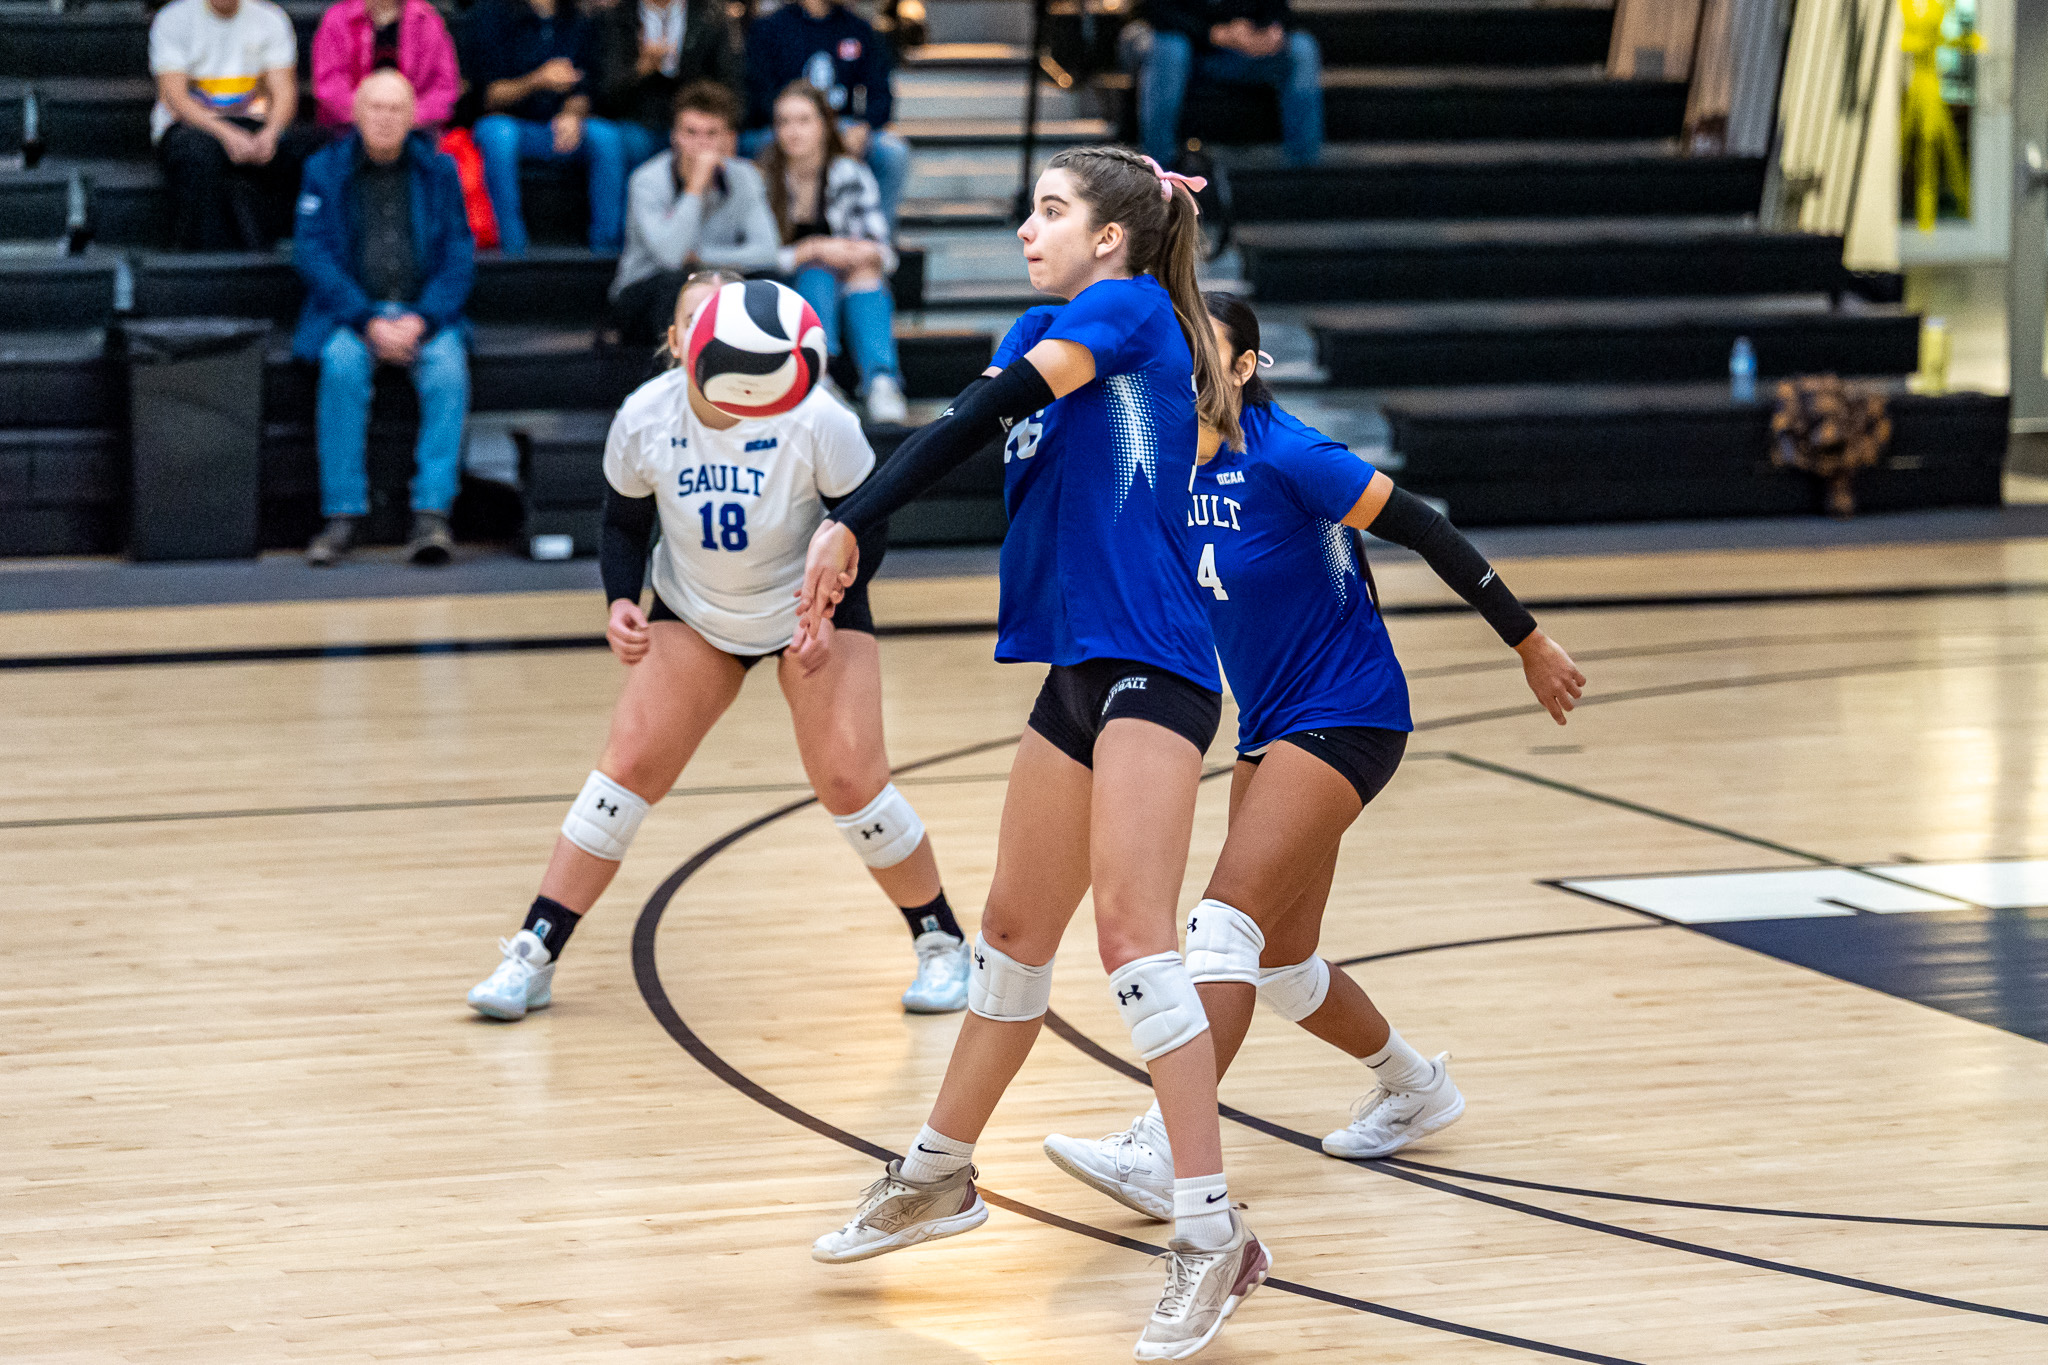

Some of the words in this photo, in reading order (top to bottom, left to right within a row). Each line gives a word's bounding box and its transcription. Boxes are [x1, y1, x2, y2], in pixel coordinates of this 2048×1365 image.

[678, 464, 765, 497] SAULT
[1215, 470, 1246, 486] OCAA
[698, 501, 749, 552] 18
[1187, 494, 1242, 532] ULT
[1196, 543, 1230, 601] 4
